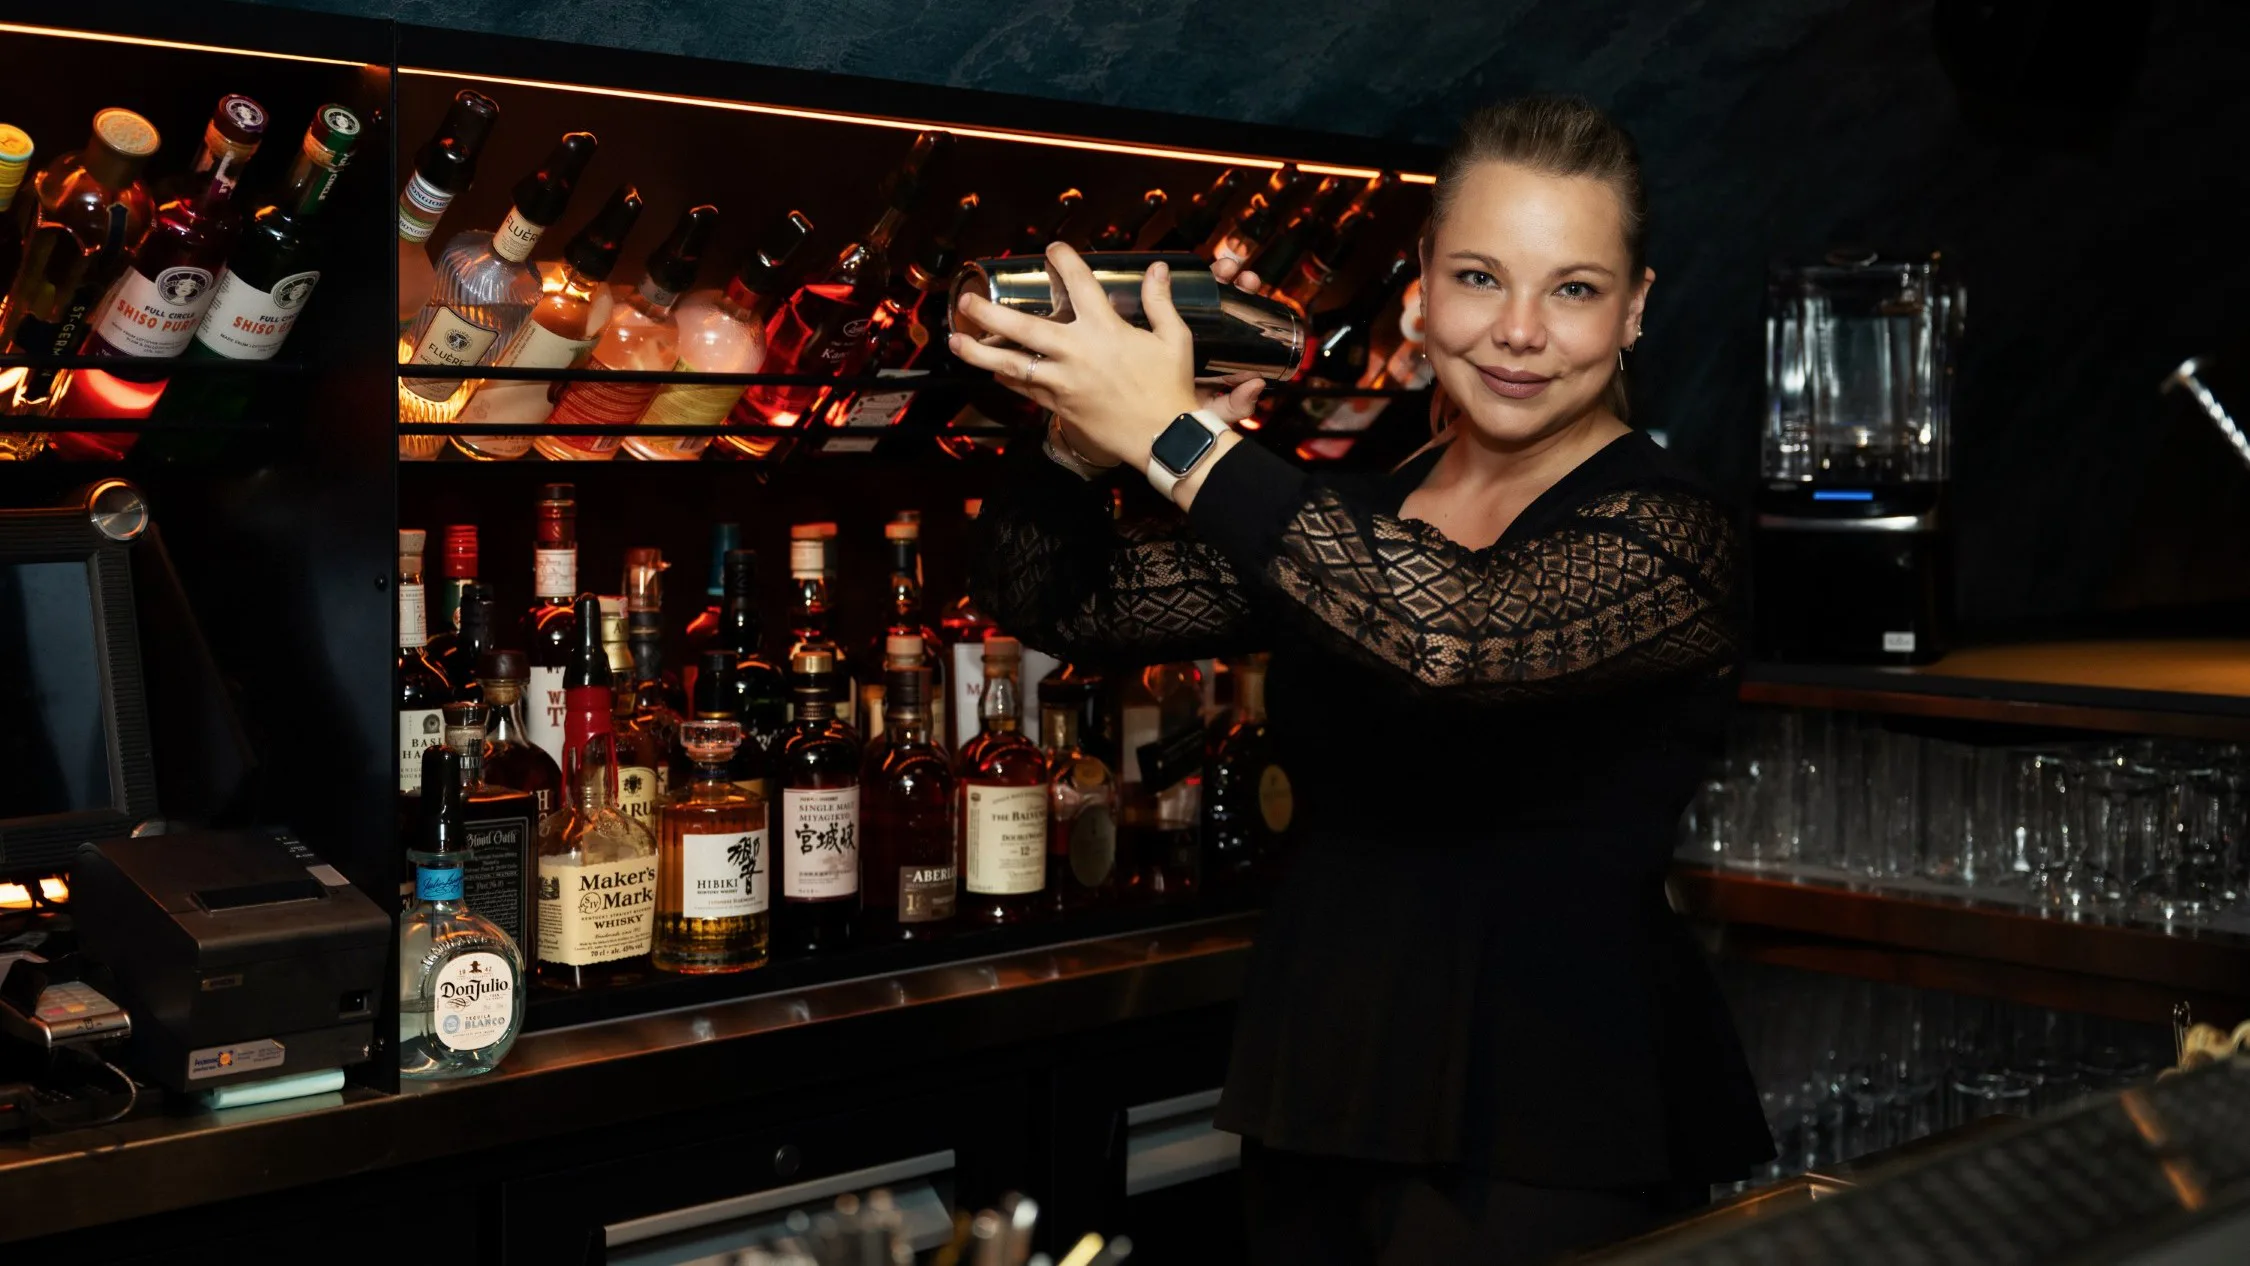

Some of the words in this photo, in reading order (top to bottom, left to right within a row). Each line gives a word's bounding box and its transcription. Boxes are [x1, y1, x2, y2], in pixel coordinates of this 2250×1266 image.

[117, 299, 159, 330] SHISO
[144, 305, 166, 319] FULL
[232, 315, 276, 336] SHISO
[259, 315, 280, 324] FULL
[799, 804, 834, 812] SINGLE
[799, 813, 851, 822] MIYAGIKYO
[1020, 846, 1031, 856] 12
[579, 867, 656, 892] Maker's
[697, 879, 738, 889] HIBIKI
[603, 887, 654, 911] Mark
[594, 914, 644, 930] WHISKY
[591, 950, 598, 958] 70
[464, 1017, 506, 1030] BLANCO
